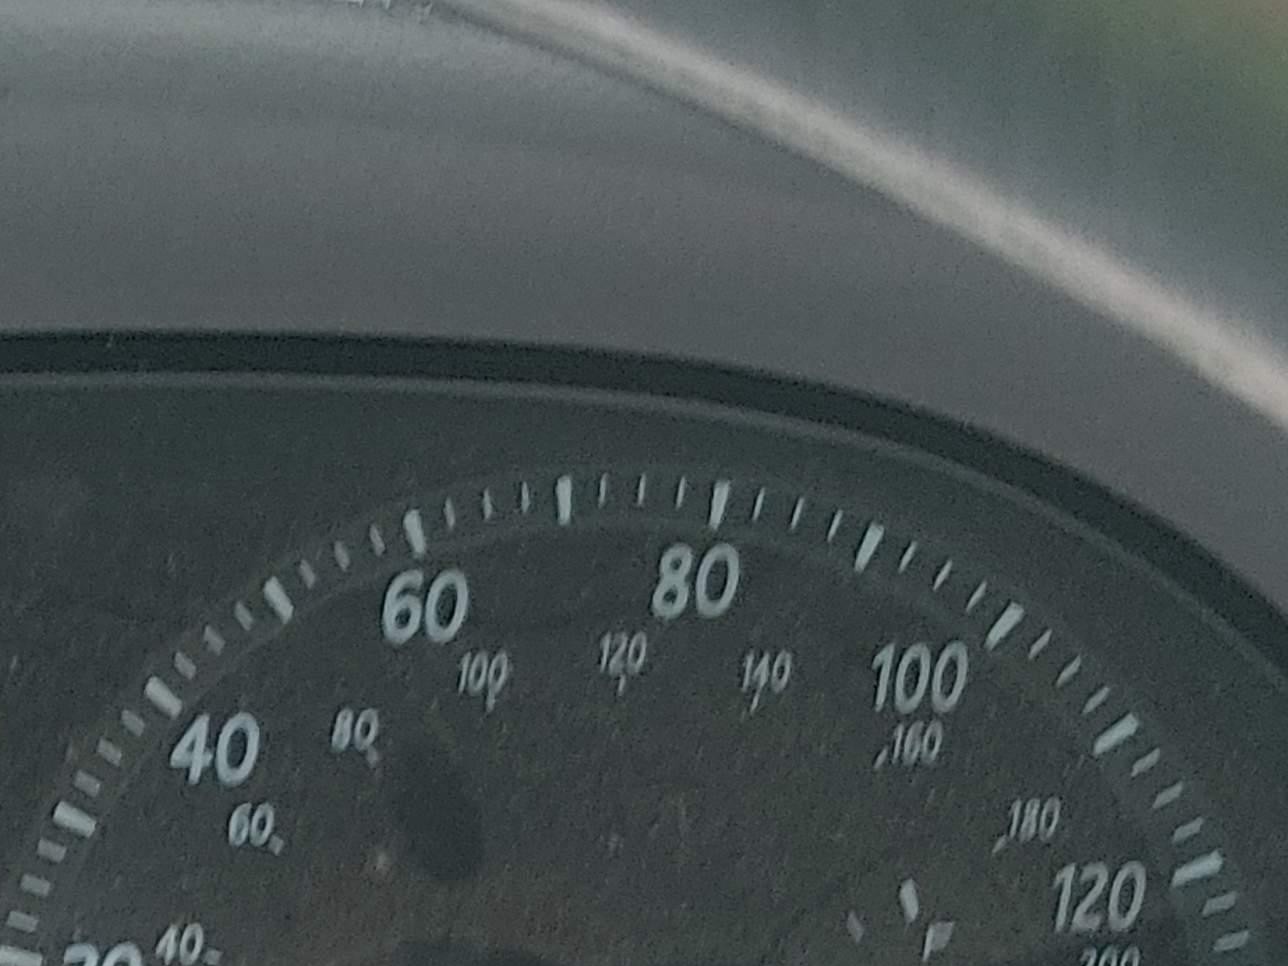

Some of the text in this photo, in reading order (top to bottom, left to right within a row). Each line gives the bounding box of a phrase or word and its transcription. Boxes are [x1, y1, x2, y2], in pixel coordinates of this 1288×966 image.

[651, 543, 740, 619] 80
[382, 568, 469, 645] 60
[458, 651, 508, 697] 100
[600, 631, 647, 676] 120
[741, 651, 793, 693] 140
[872, 640, 968, 714] 100
[171, 711, 260, 786] 40
[332, 709, 379, 752] 80
[891, 721, 945, 766] 160
[228, 803, 275, 847] 60
[1007, 797, 1061, 841] 180
[1054, 861, 1147, 933] 120
[156, 923, 205, 966] 40
